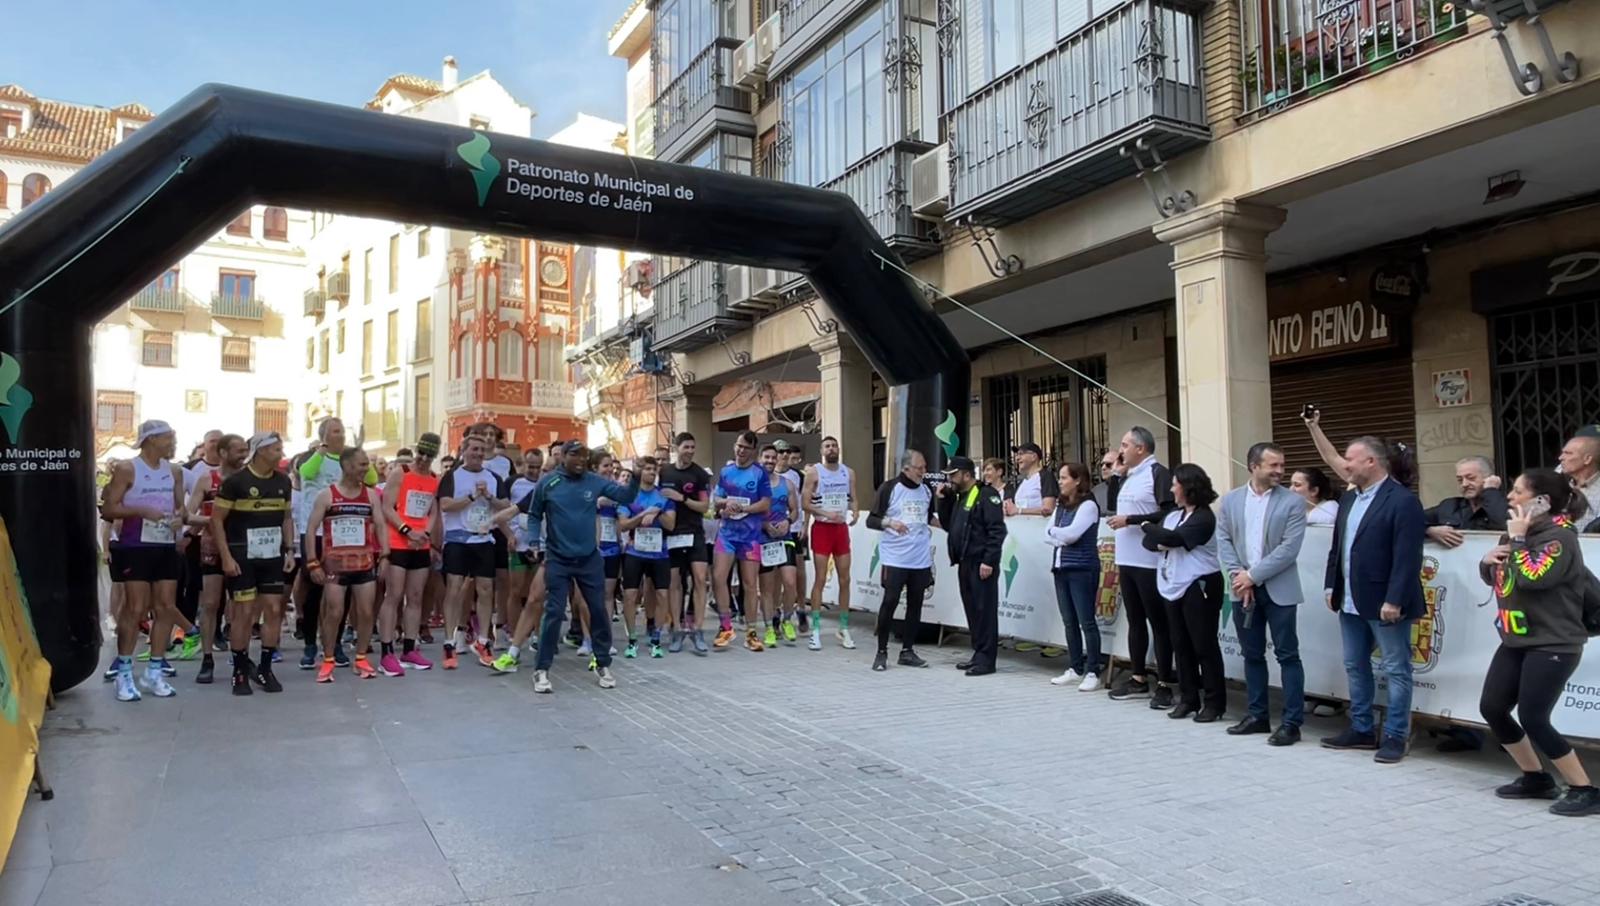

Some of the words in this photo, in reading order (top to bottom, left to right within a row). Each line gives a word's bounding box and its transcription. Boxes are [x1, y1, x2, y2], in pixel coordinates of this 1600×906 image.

[507, 158, 590, 186] Patronato
[594, 172, 670, 198] Municipal
[674, 185, 694, 201] de
[506, 177, 584, 204] Deportes
[588, 191, 610, 208] de
[613, 194, 653, 213] Jaén
[1269, 312, 1304, 357] NTO
[1310, 300, 1365, 349] REINO
[6, 447, 67, 461] Municipal
[69, 448, 81, 459] de
[20, 460, 38, 471] de
[40, 460, 70, 471] Jaén
[1564, 696, 1600, 712] Depo
